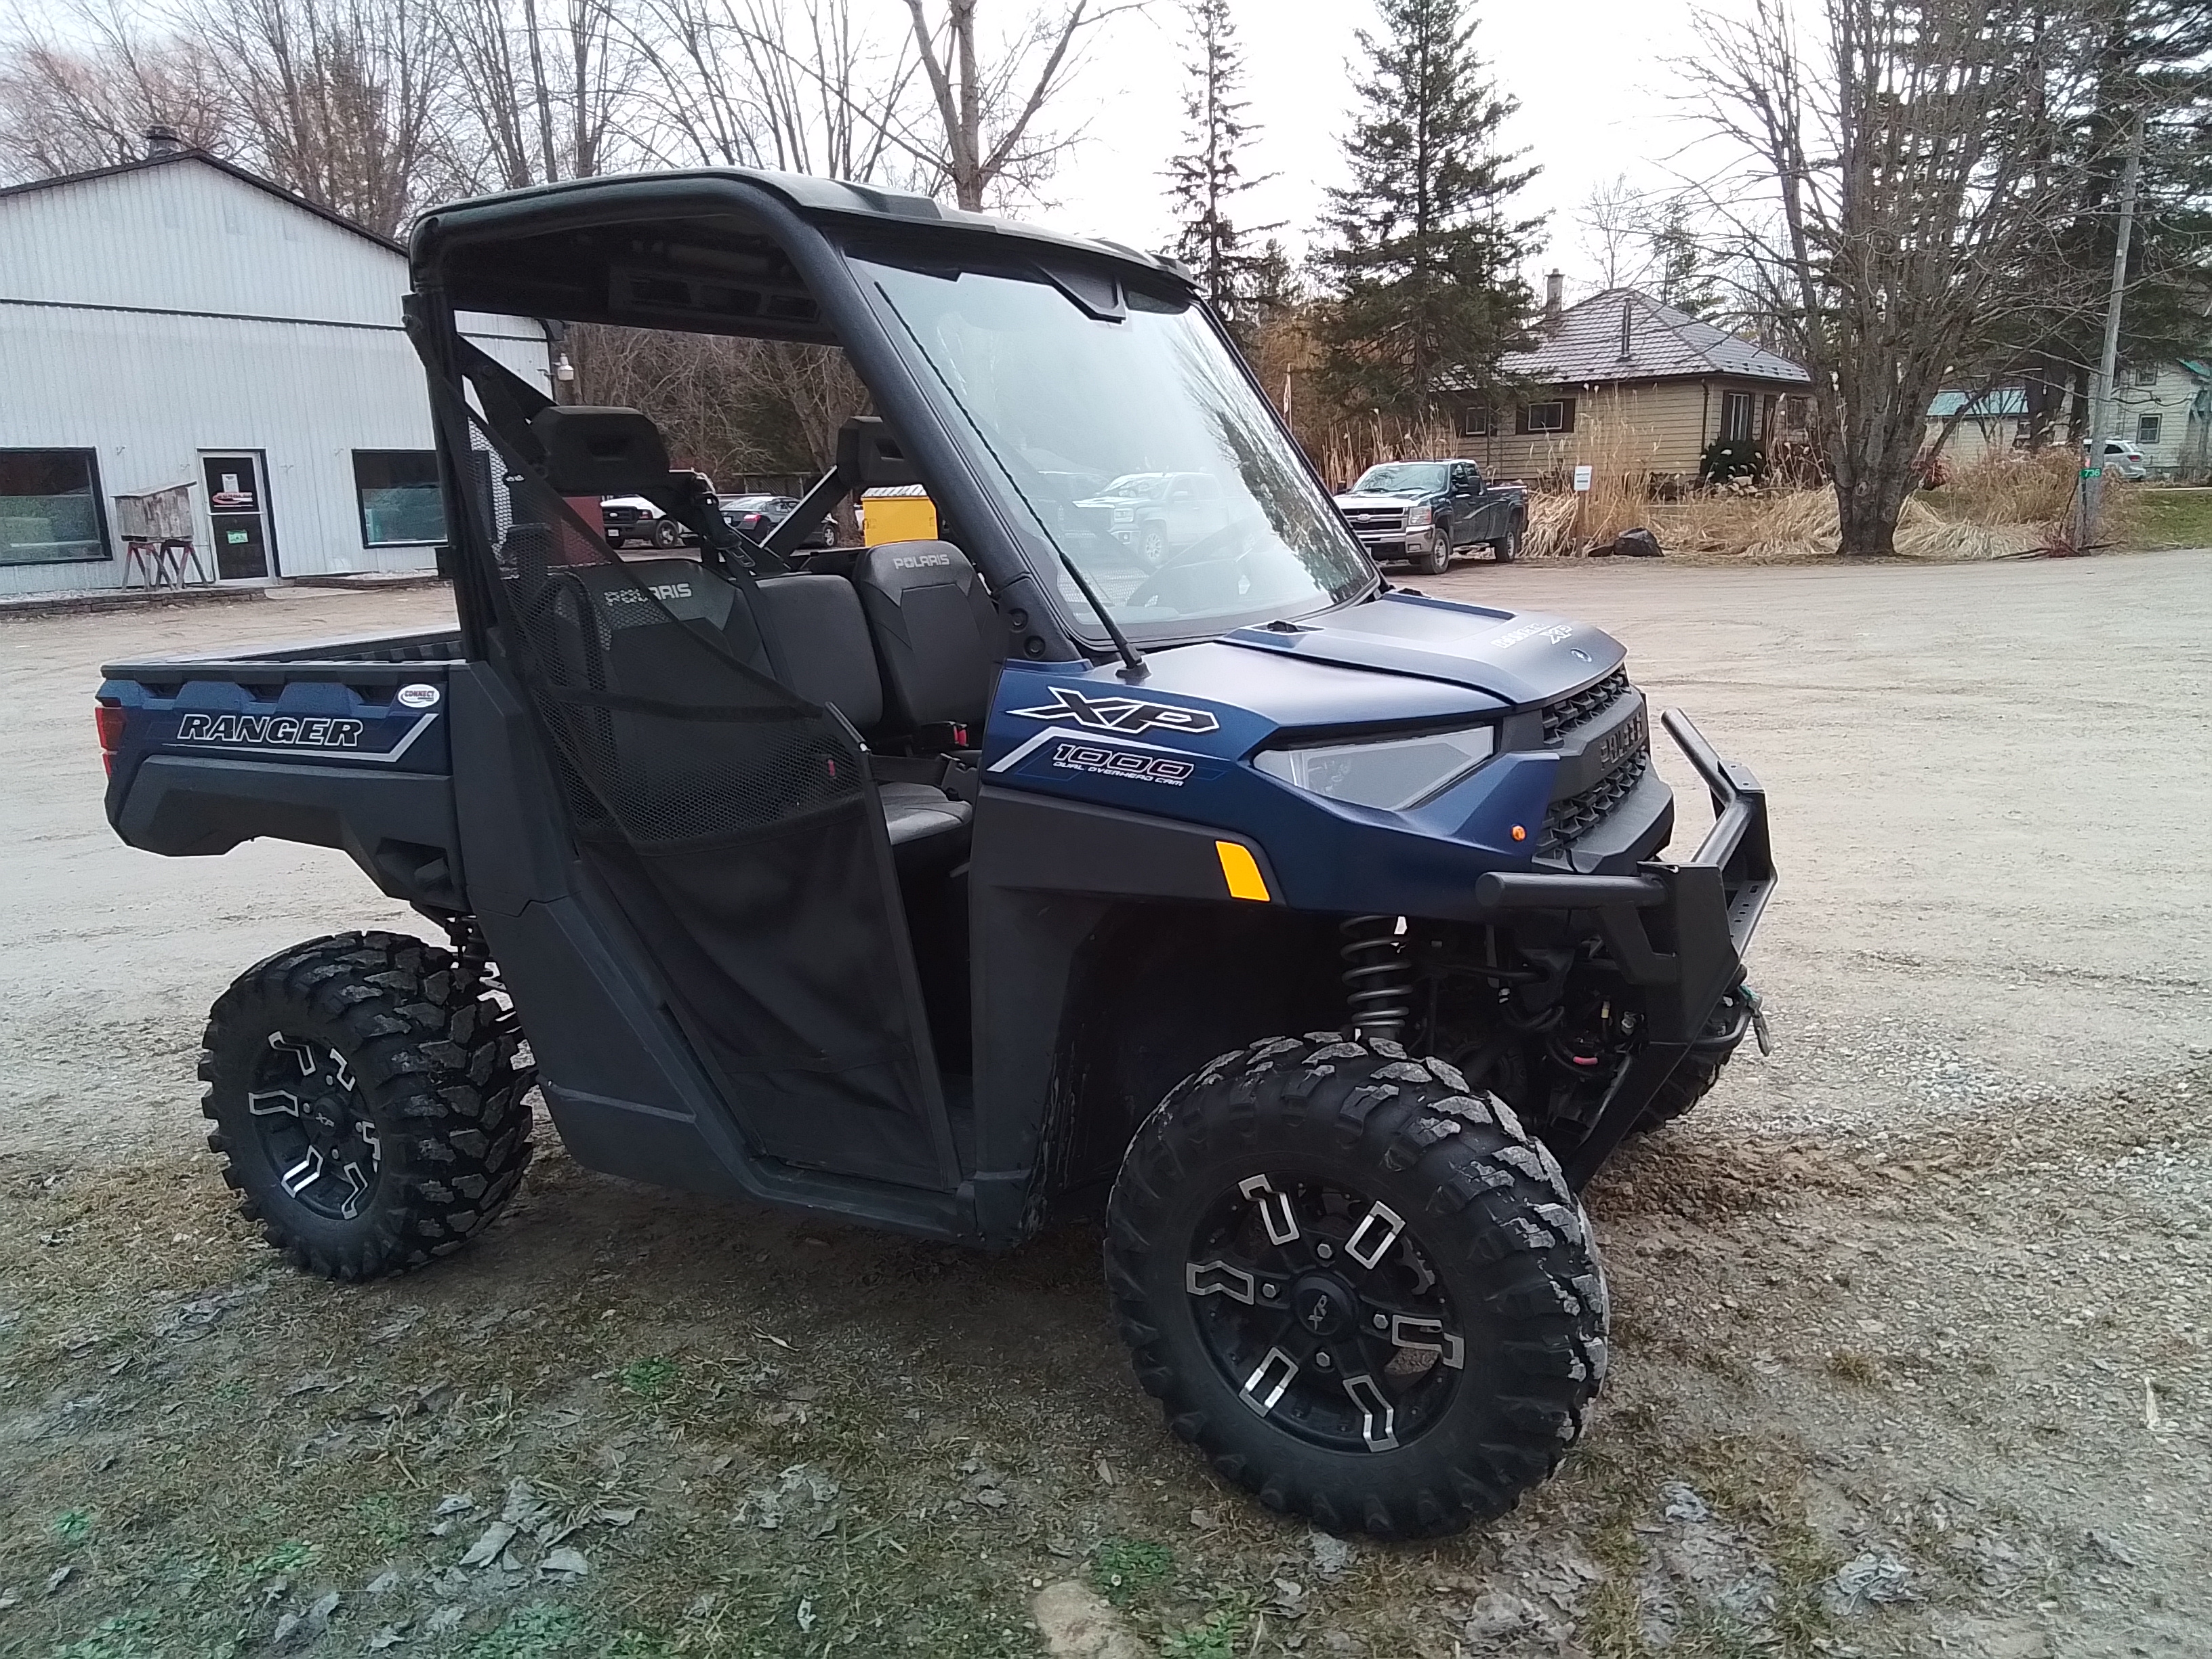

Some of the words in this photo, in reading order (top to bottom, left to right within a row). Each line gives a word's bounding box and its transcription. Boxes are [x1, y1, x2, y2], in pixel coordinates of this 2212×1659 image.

[2084, 468, 2100, 477] 736
[893, 554, 950, 569] POLARIS
[1005, 686, 1220, 734] XP
[177, 714, 363, 746] RANGER
[1052, 743, 1195, 780] 1000
[1052, 762, 1085, 771] DUAL
[1087, 766, 1154, 782] OVERHEAD
[1154, 778, 1185, 787] CAM
[1308, 1294, 1328, 1330] XP
